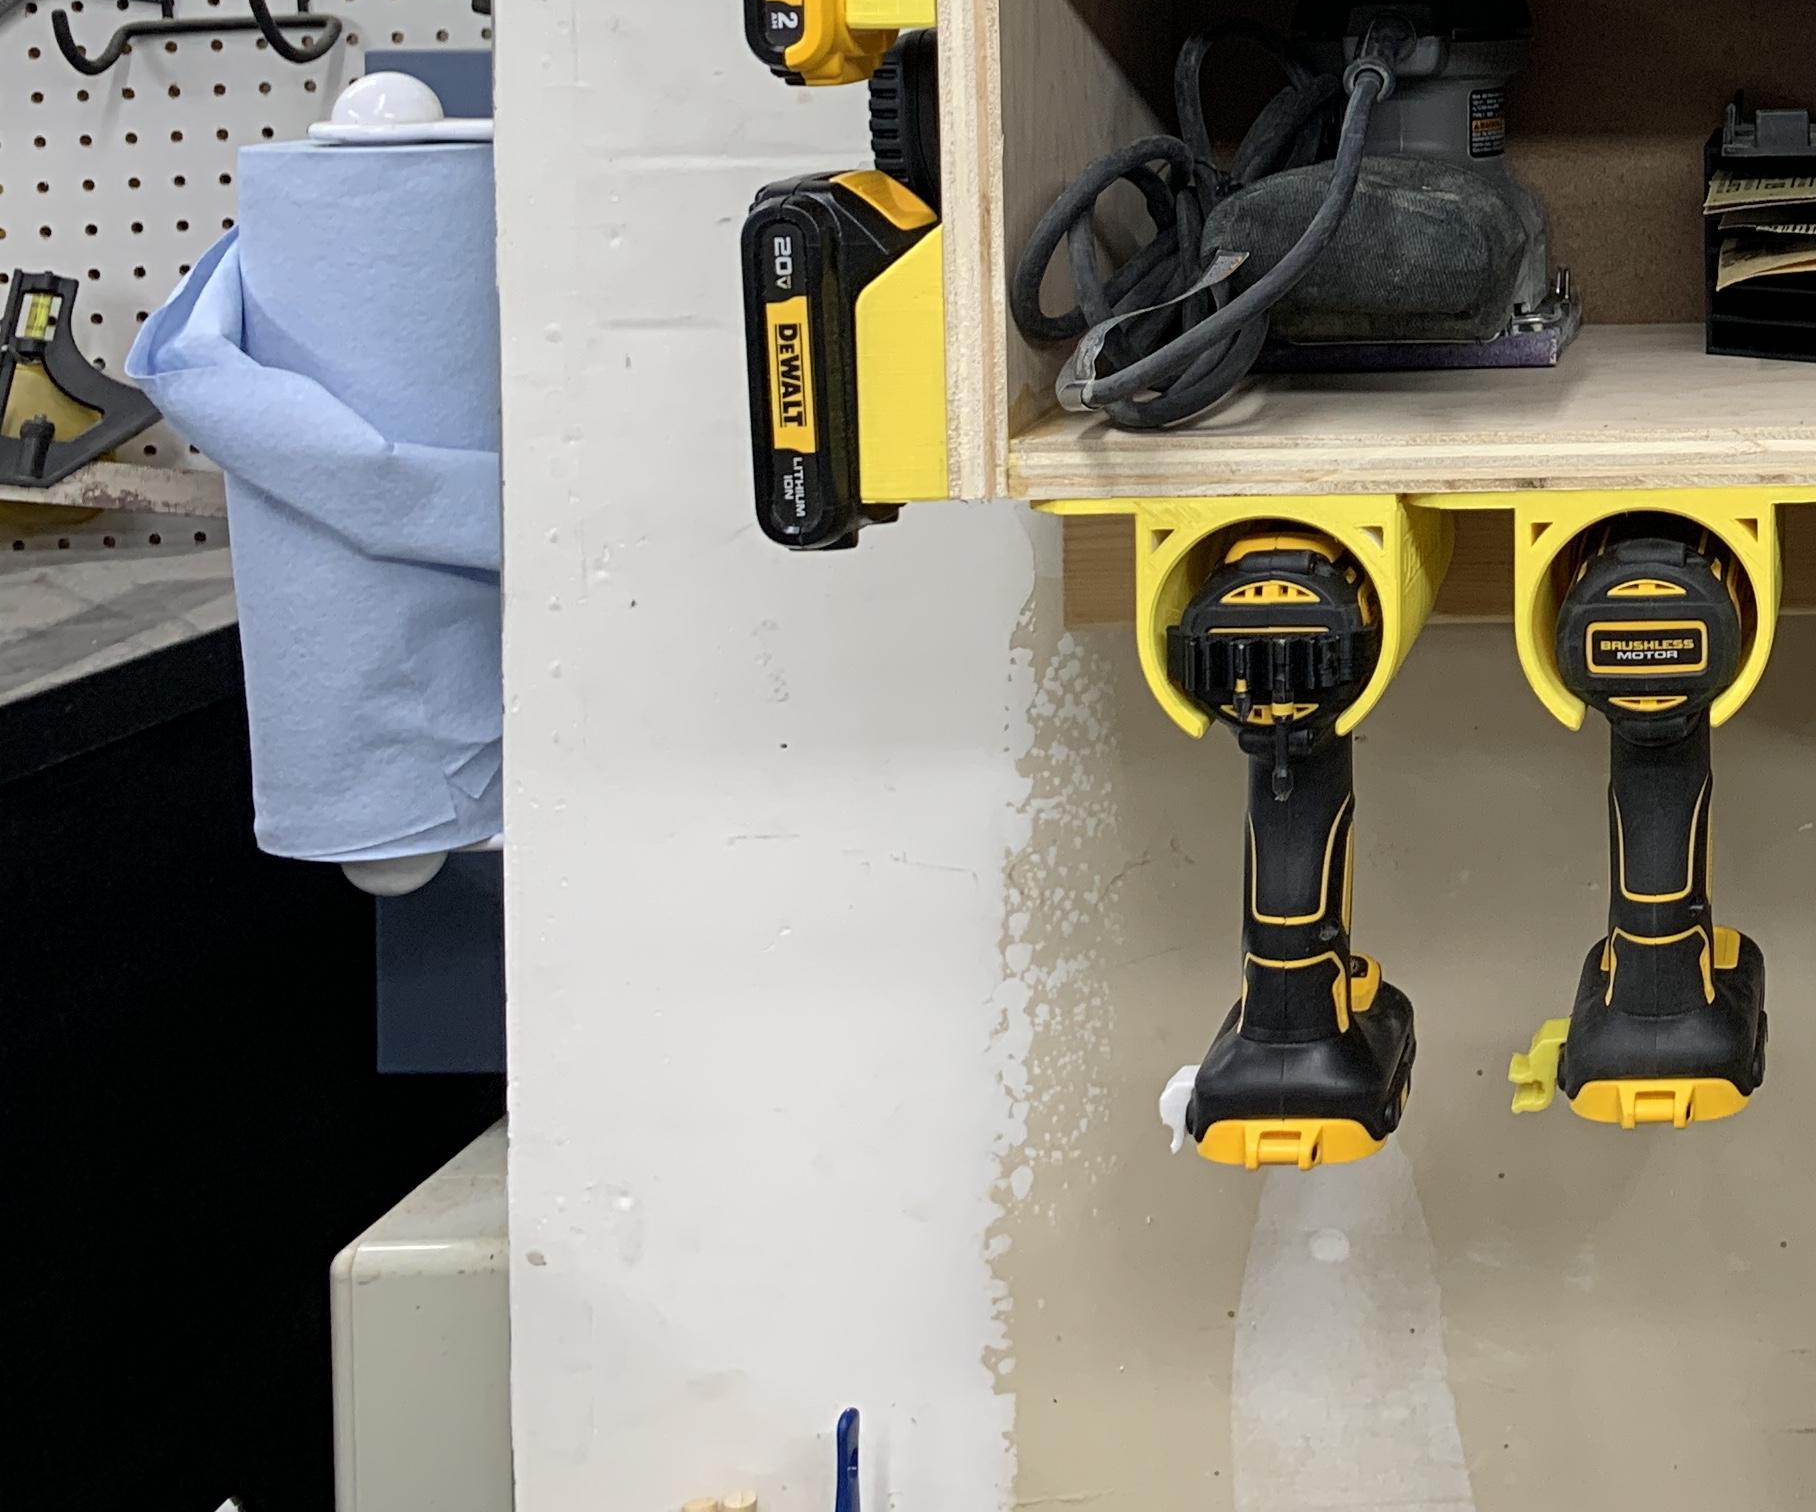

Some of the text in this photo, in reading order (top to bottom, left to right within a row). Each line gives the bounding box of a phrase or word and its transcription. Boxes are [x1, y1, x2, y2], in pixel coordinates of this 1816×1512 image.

[777, 11, 799, 30] 2
[772, 235, 793, 289] 20V
[776, 323, 807, 428] DEWALT
[783, 474, 793, 501] ION
[792, 456, 807, 518] LITHIUM
[1599, 638, 1695, 651] BRUSHLESS
[1616, 650, 1679, 660] MOTOR
